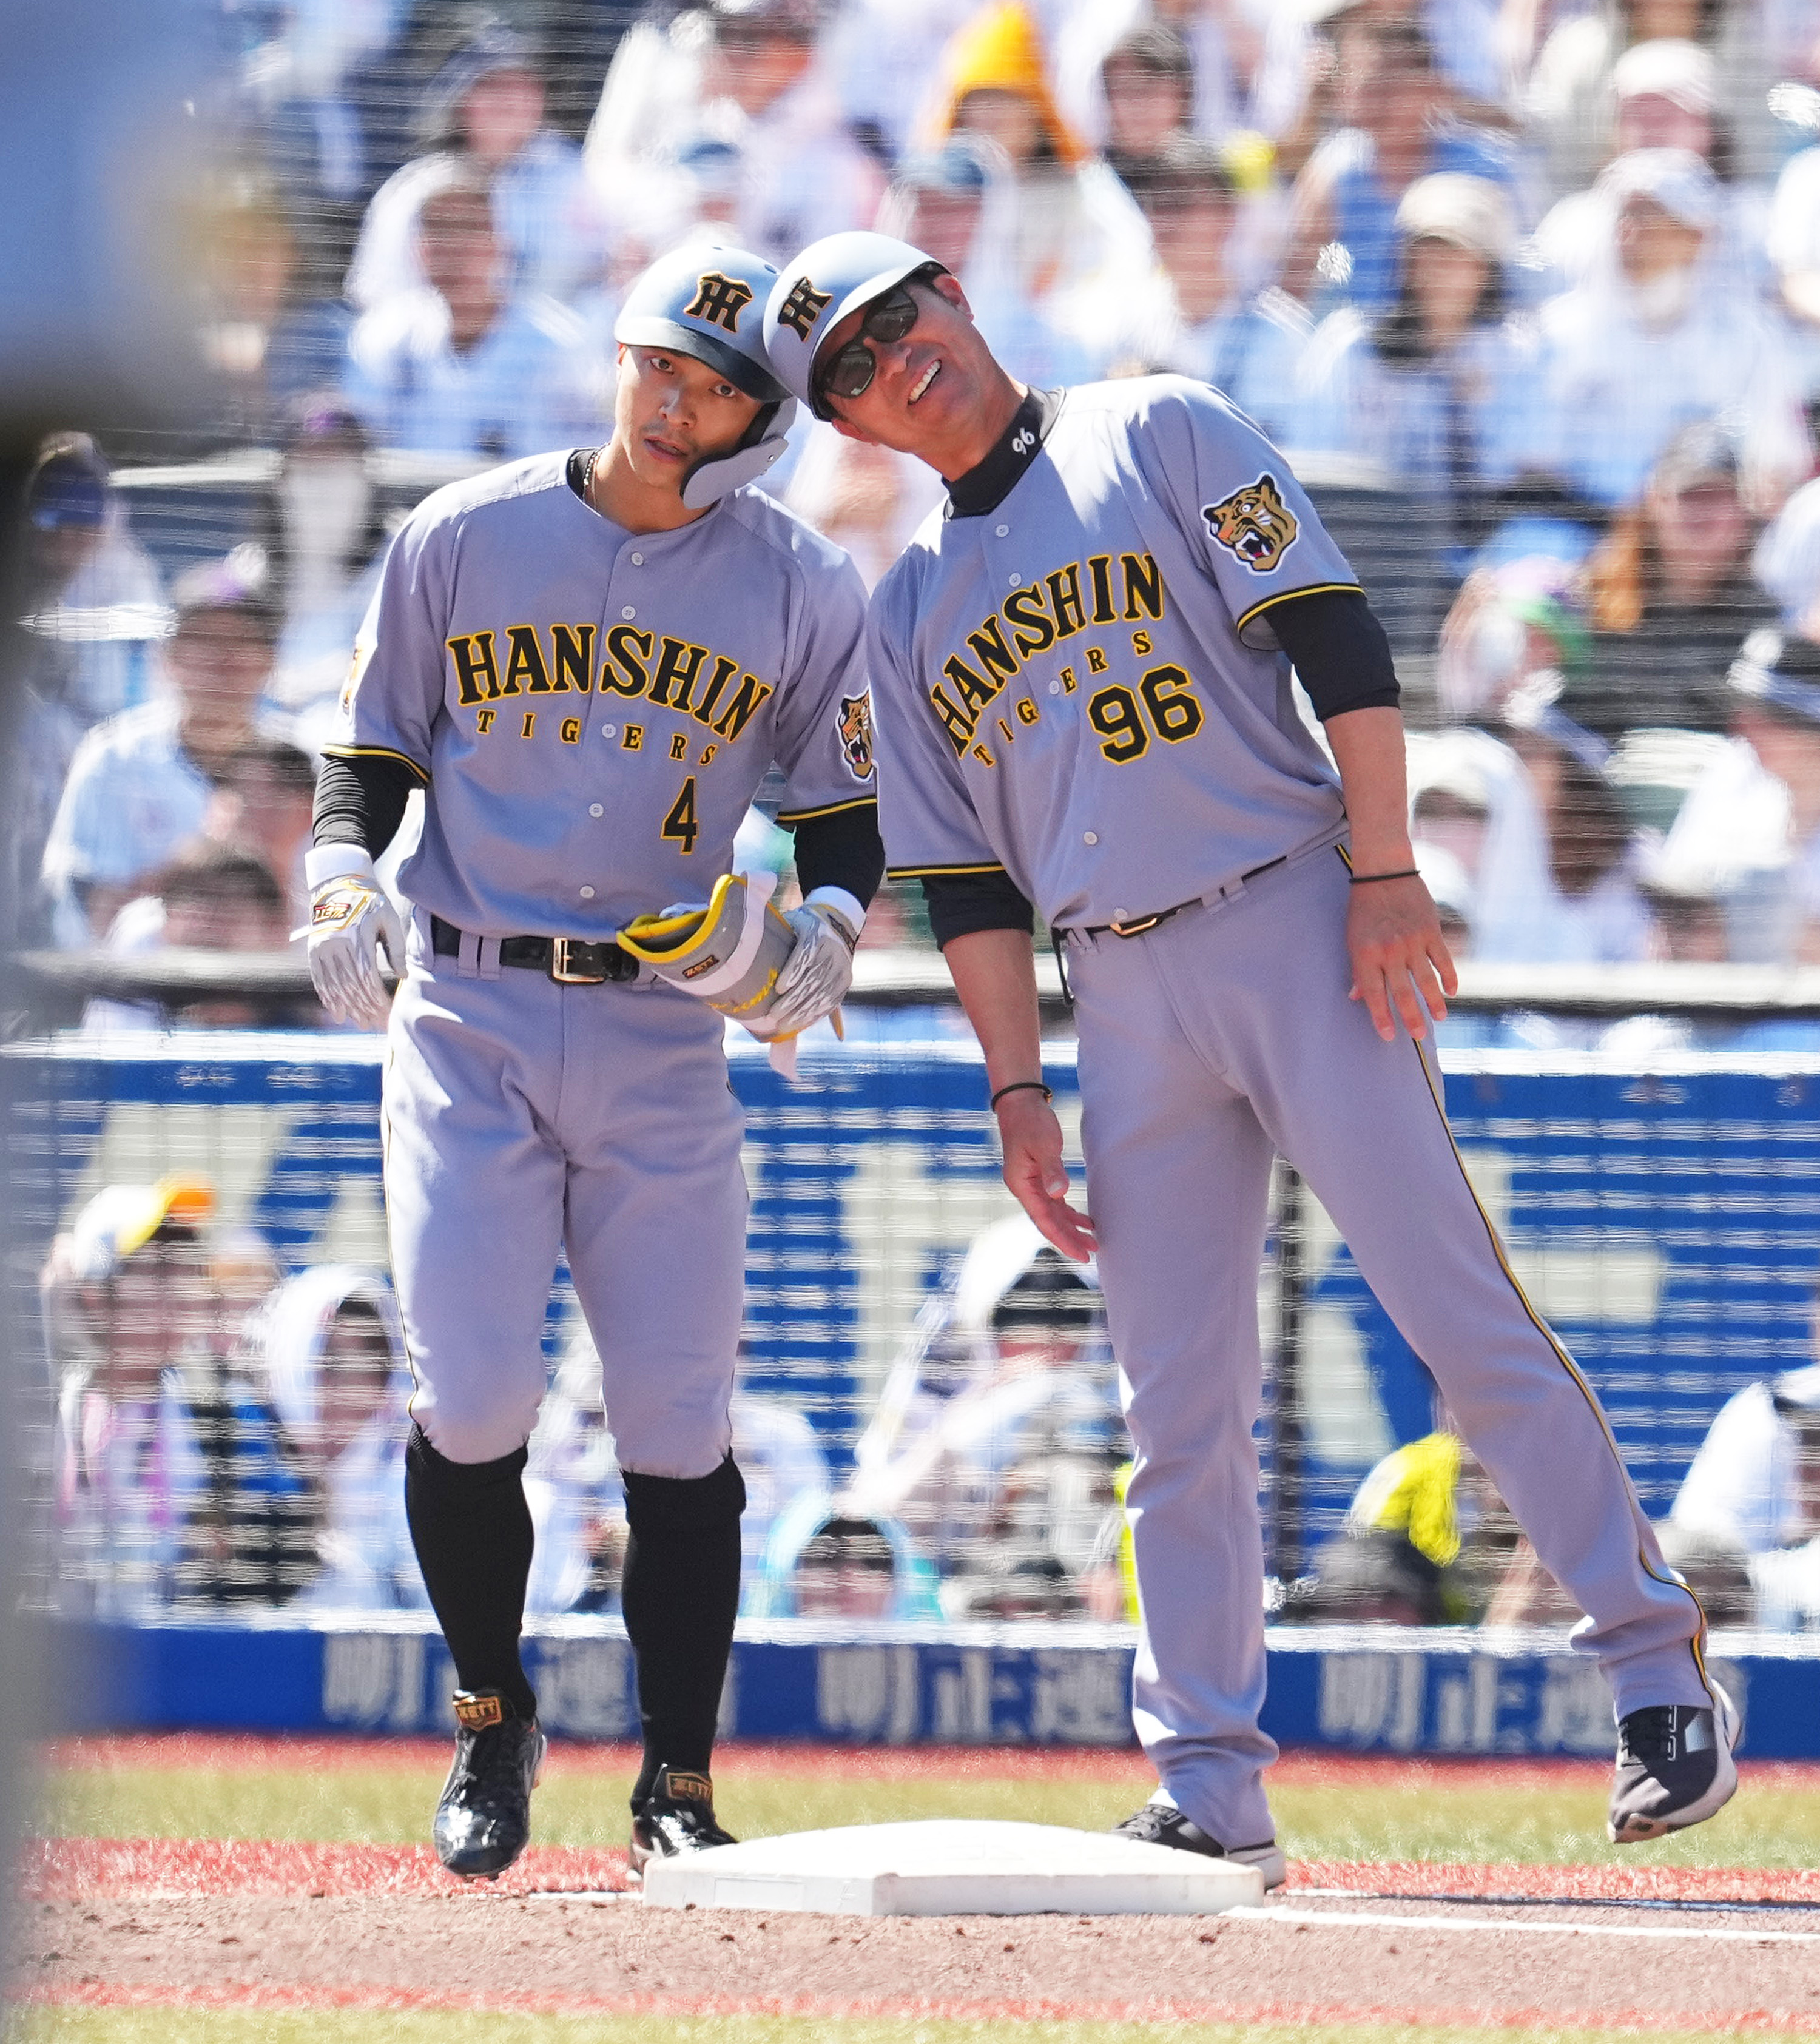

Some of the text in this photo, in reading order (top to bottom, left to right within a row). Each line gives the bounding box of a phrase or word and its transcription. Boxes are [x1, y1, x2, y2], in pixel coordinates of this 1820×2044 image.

[1011, 426, 1036, 455] 96
[445, 622, 774, 745] HANSHIN
[929, 551, 1165, 759] HANSHIN
[972, 629, 1153, 768] TIGERS
[476, 708, 719, 767] TIGERS
[1087, 662, 1205, 766] 96
[659, 775, 698, 856] 4
